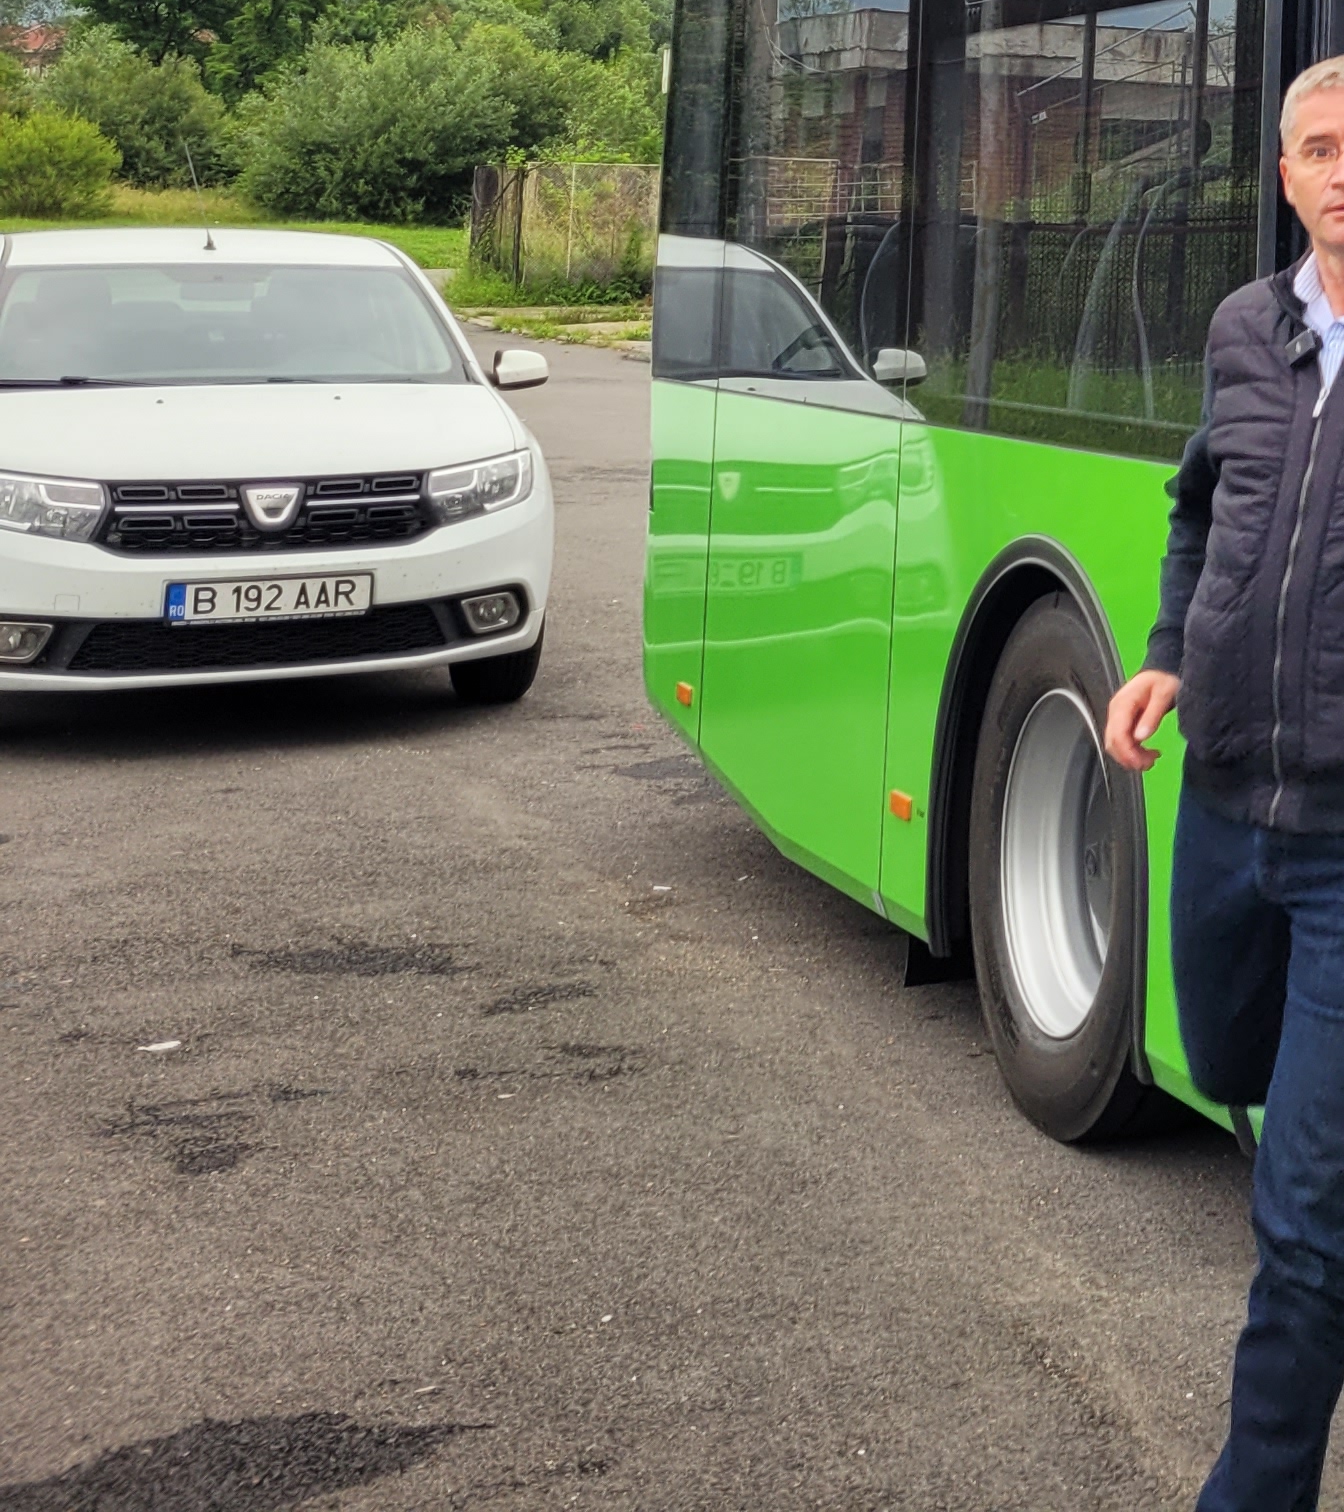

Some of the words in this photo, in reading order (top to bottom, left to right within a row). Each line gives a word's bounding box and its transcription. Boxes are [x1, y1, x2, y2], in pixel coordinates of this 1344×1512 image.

[256, 493, 290, 501] DACIA
[169, 604, 185, 617] RO
[193, 586, 217, 615] B
[231, 583, 284, 614] 192
[293, 579, 357, 610] AAR
